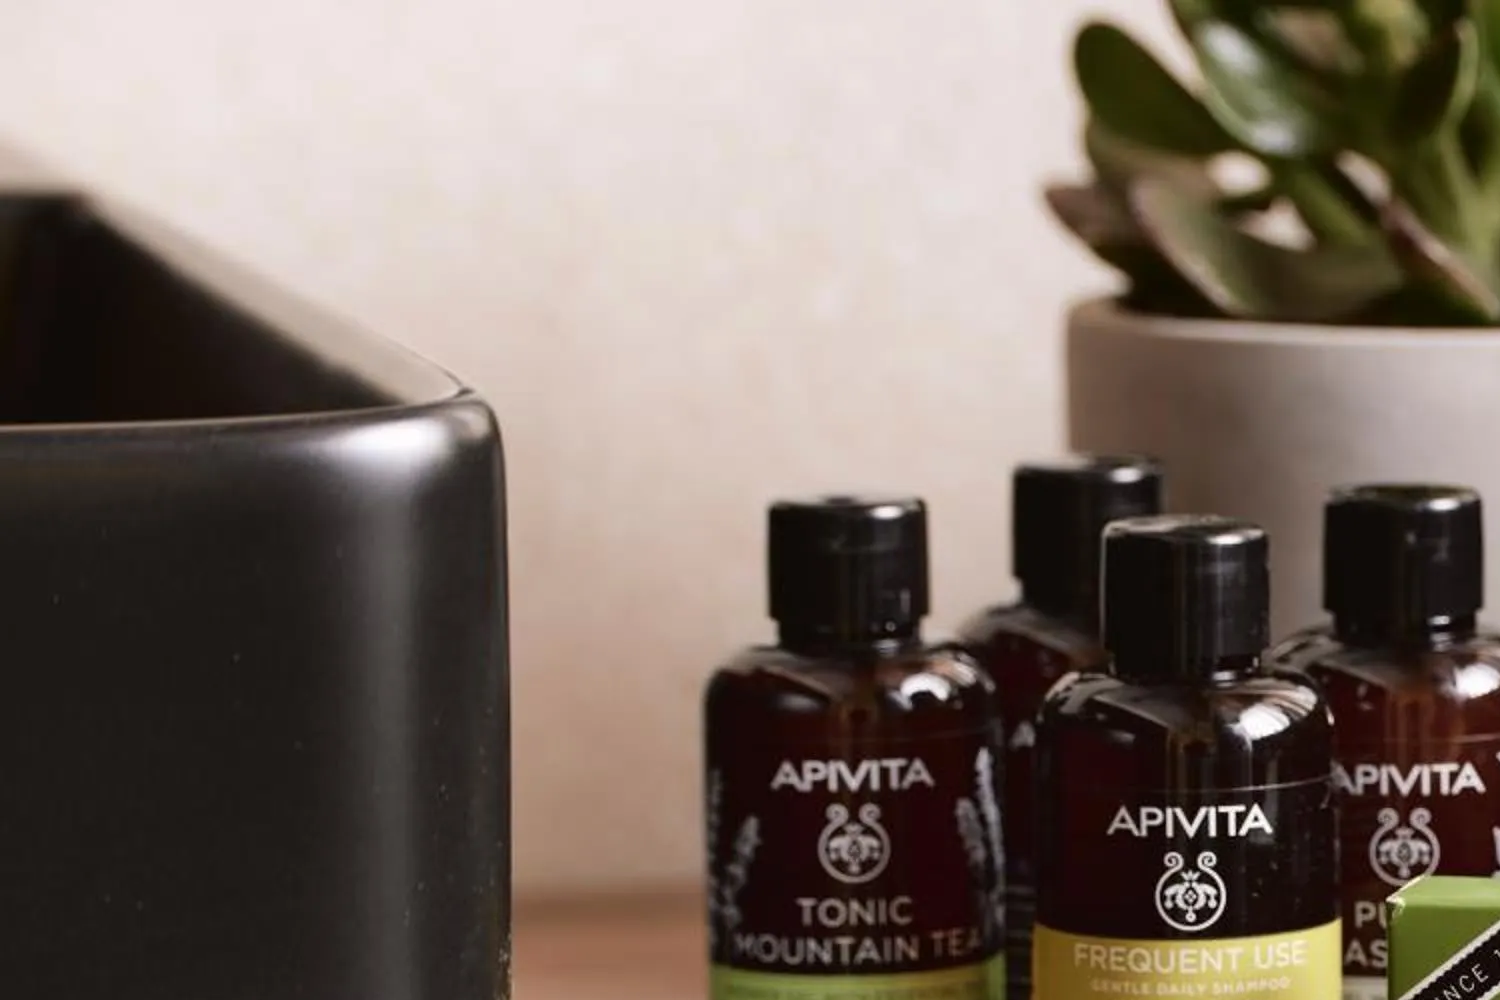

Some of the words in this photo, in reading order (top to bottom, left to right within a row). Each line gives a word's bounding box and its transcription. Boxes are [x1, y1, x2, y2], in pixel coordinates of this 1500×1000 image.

[770, 758, 934, 792] APIVITA
[1330, 760, 1487, 798] APIVITA
[1107, 804, 1274, 838] APIVITA
[796, 896, 913, 928] TONIC
[733, 932, 920, 966] MOUNTAIN
[1074, 943, 1245, 975] FREQUENT
[1253, 940, 1309, 970] USE
[1090, 979, 1149, 995] GENTLE
[1157, 981, 1206, 996] DAILY
[1212, 976, 1293, 996] SHAMPOO
